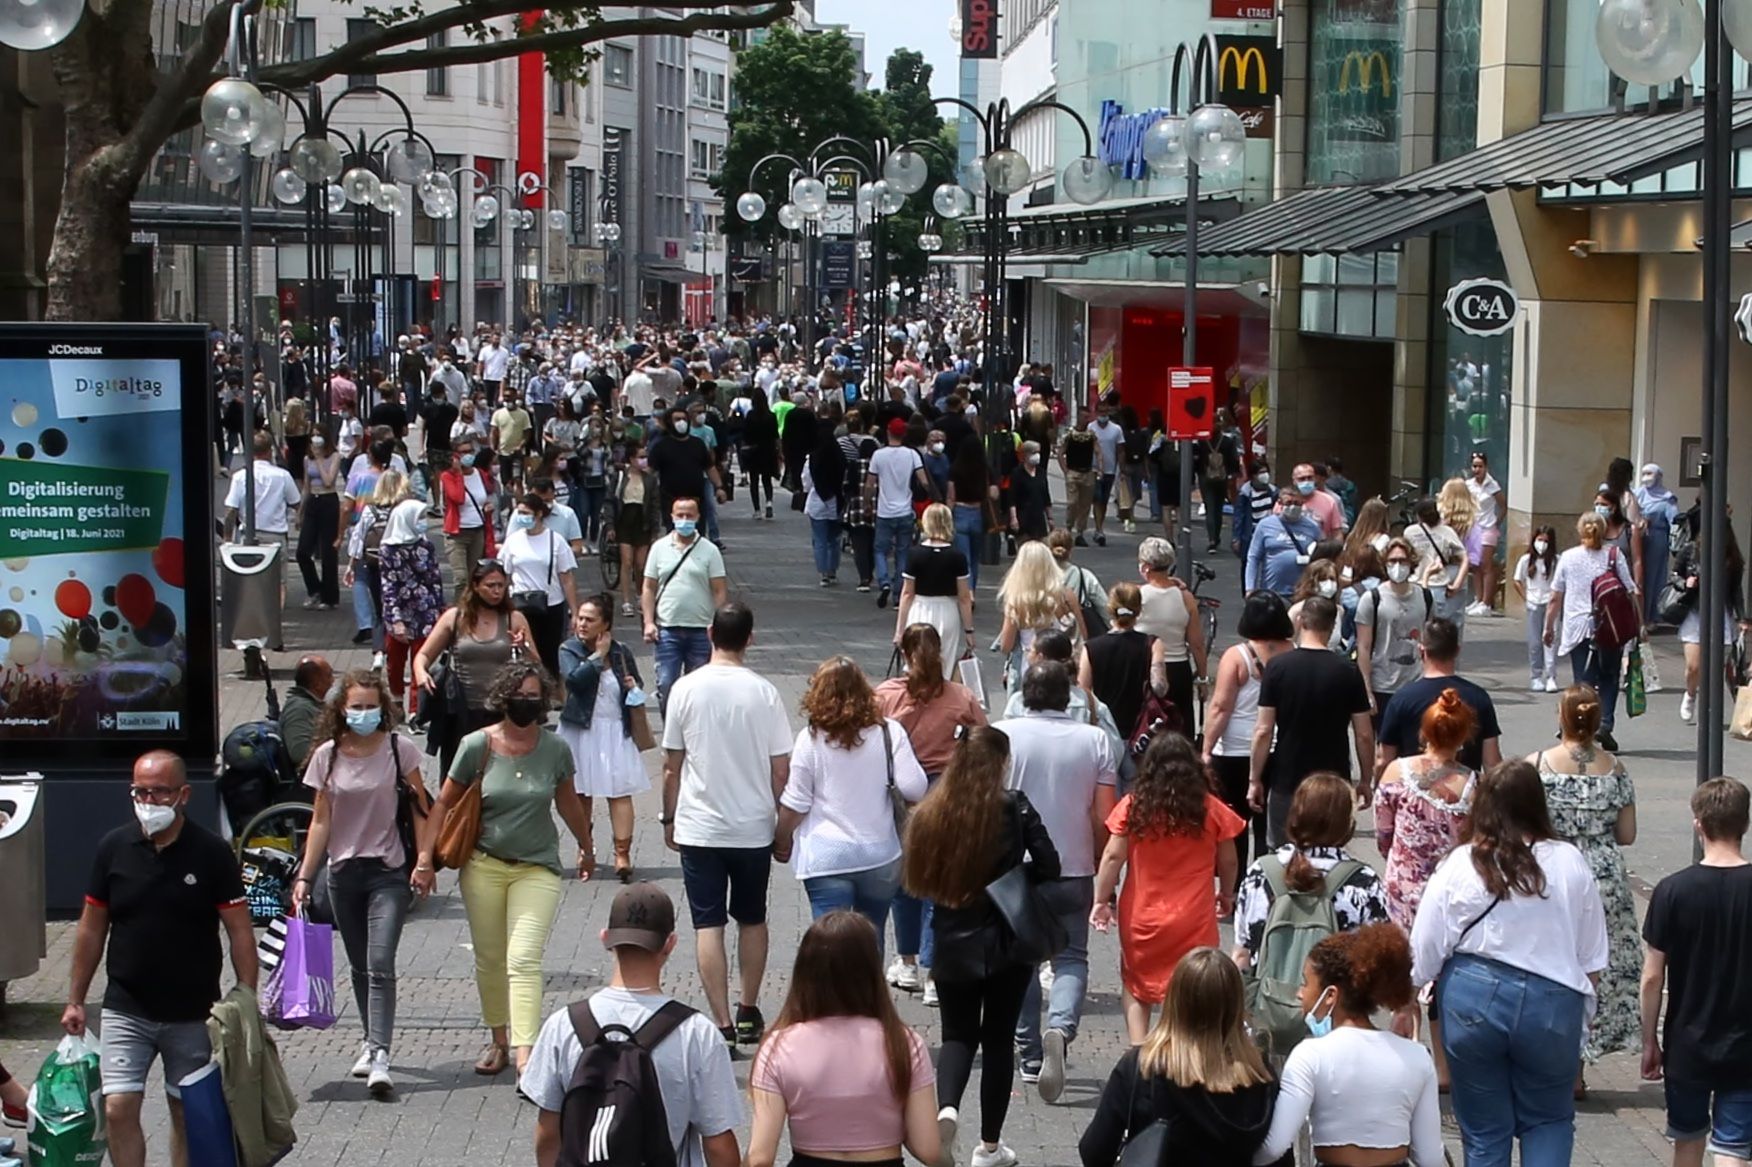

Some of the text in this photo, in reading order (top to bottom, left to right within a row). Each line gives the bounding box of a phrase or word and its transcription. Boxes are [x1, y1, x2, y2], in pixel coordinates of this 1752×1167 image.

[1236, 8, 1271, 18] 4. ETAGE
[964, 0, 993, 51] Sup
[1461, 294, 1508, 320] C&A
[48, 344, 103, 355] JCDecaux
[75, 377, 162, 397] Digitaltag
[8, 481, 125, 500] Digitalisierung
[0, 503, 151, 521] meinsam gestalten
[10, 528, 59, 540] Digitaltag
[66, 528, 79, 538] 18.
[81, 528, 102, 538] Juni
[103, 529, 125, 538] 2021
